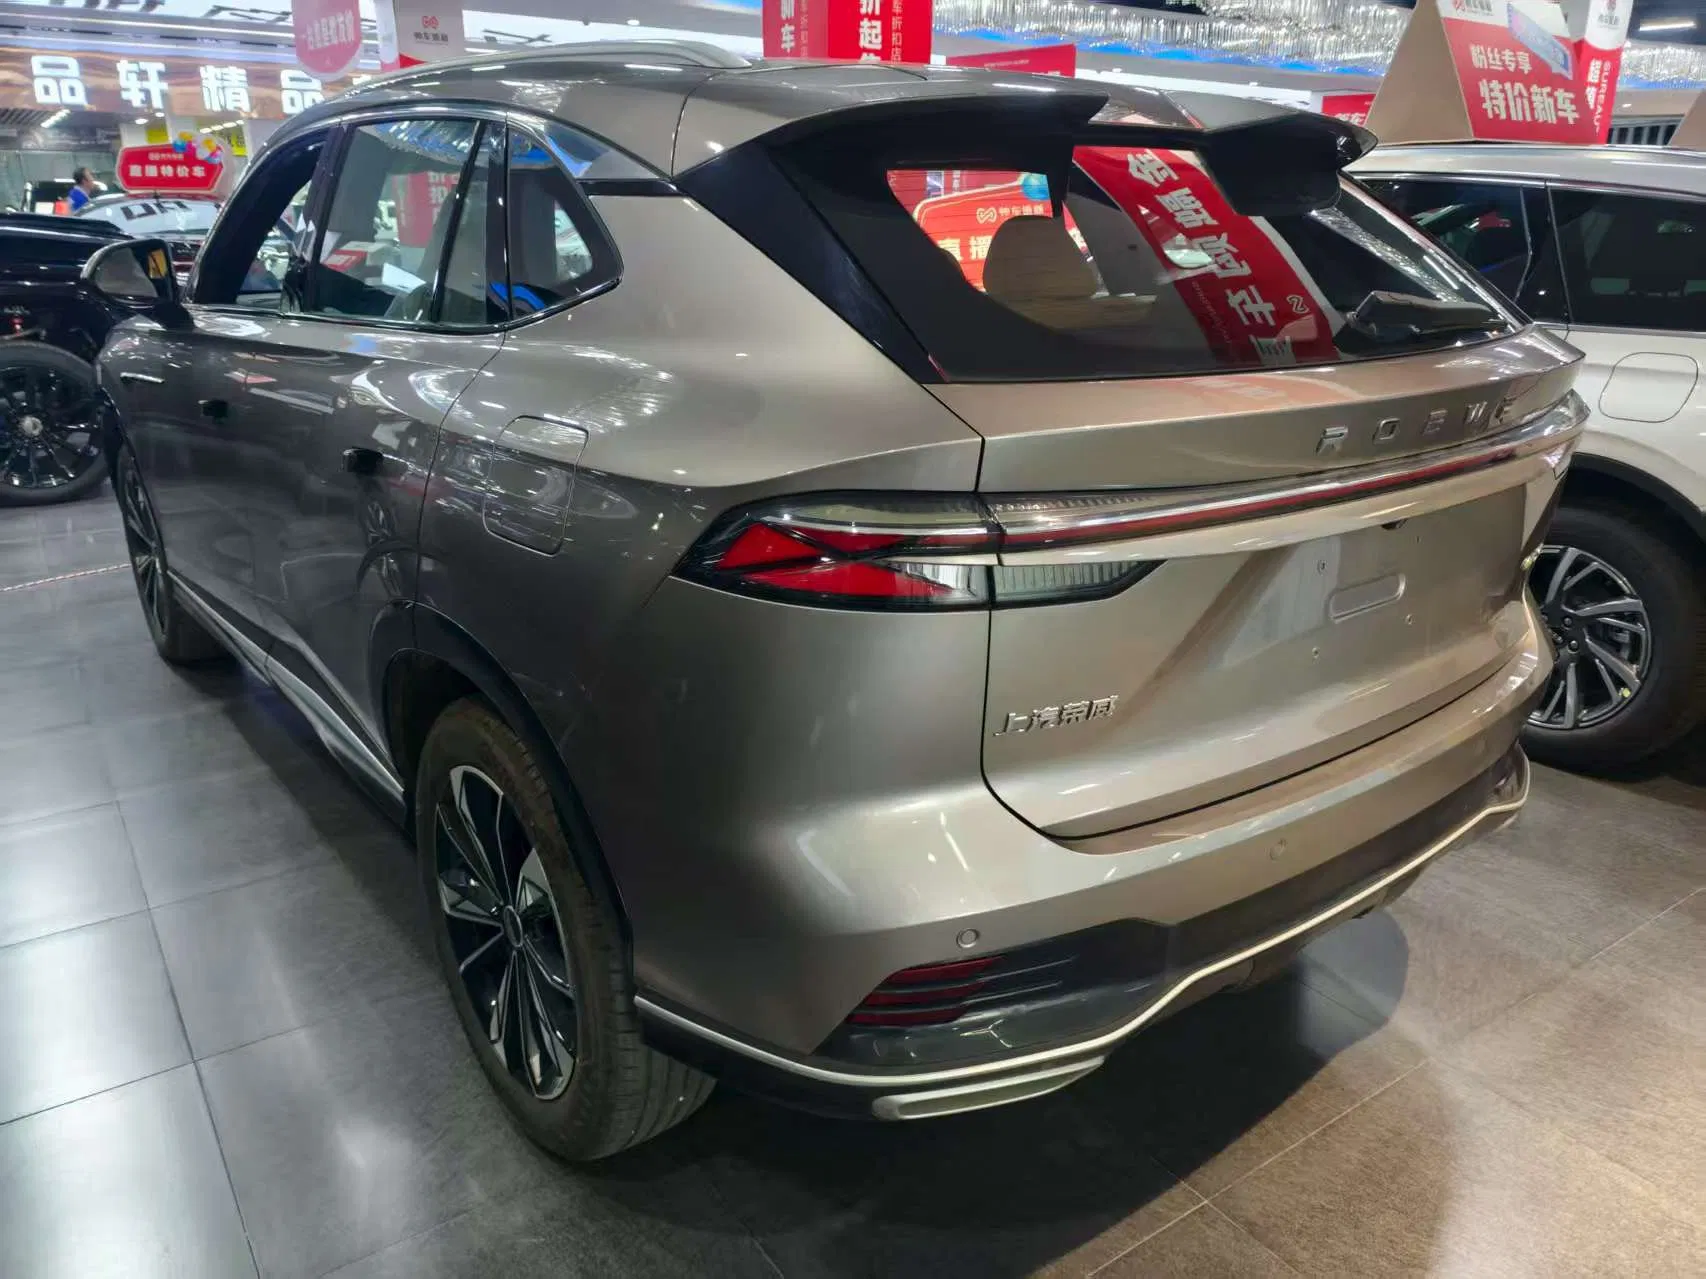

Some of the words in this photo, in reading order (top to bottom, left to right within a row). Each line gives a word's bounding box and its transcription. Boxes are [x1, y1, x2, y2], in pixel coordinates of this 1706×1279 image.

[1469, 44, 1532, 75] 粉丝专享
[30, 55, 372, 114] 品轩精品
[1478, 79, 1580, 125] 特价新车
[1316, 396, 1514, 455] ROEWE
[993, 693, 1120, 737] 上汽荣威
